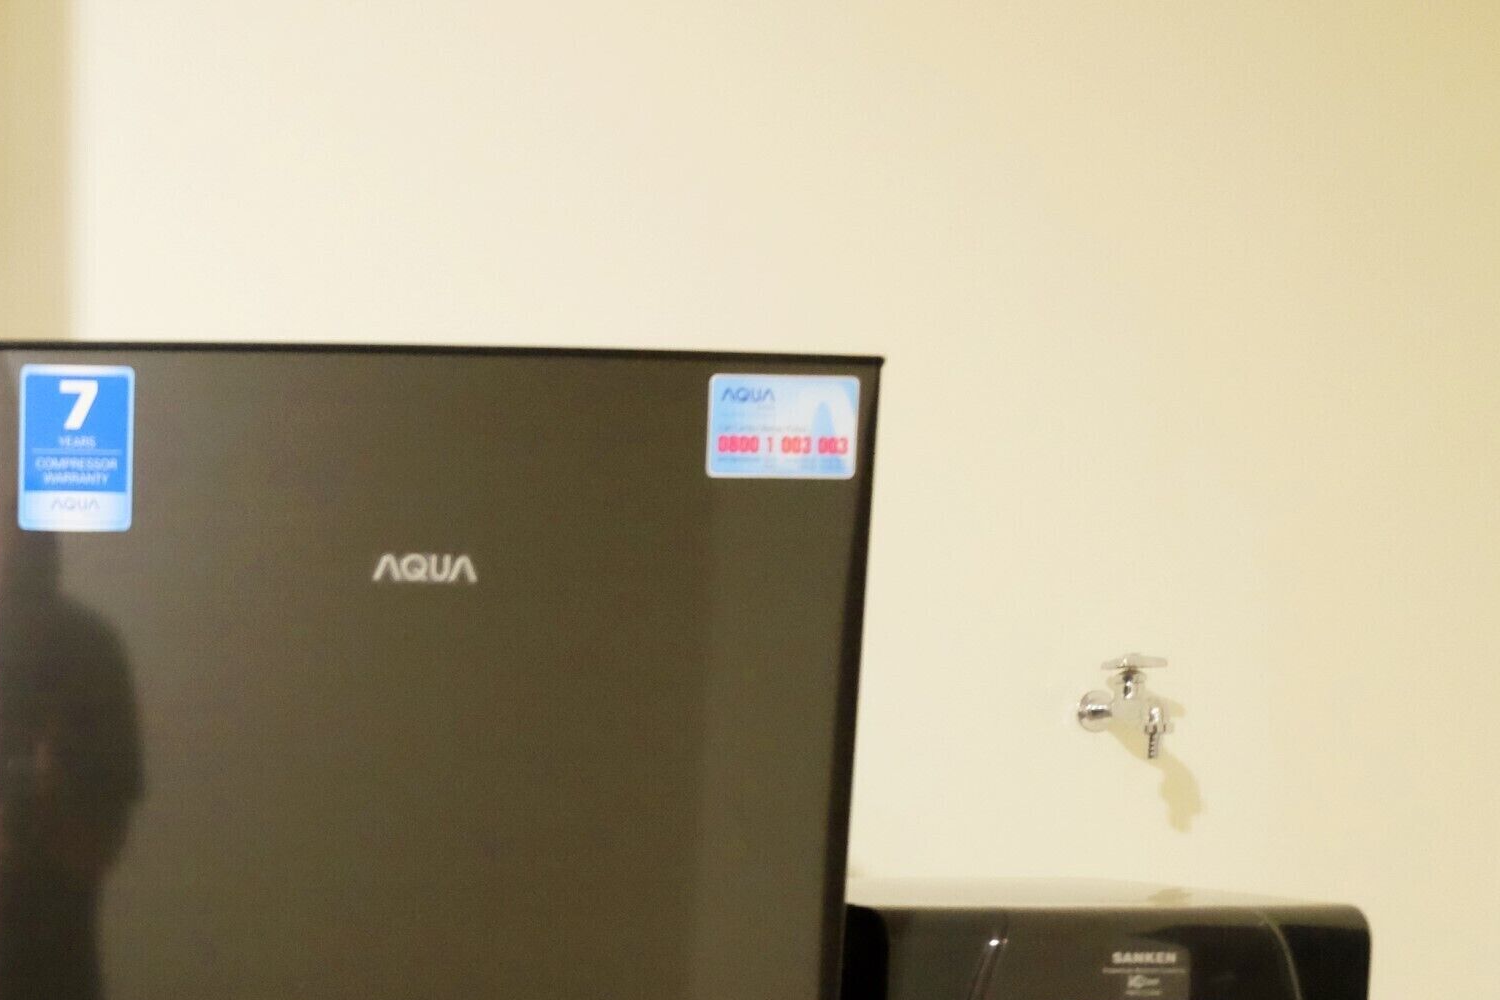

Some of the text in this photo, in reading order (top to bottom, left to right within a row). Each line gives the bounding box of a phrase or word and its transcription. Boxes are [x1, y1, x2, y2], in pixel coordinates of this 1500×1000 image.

[721, 387, 775, 402] AQUA
[59, 380, 99, 431] 7
[35, 456, 118, 470] COMPRESSOR
[372, 553, 478, 582] AQUA
[1111, 951, 1177, 965] SANKEN
